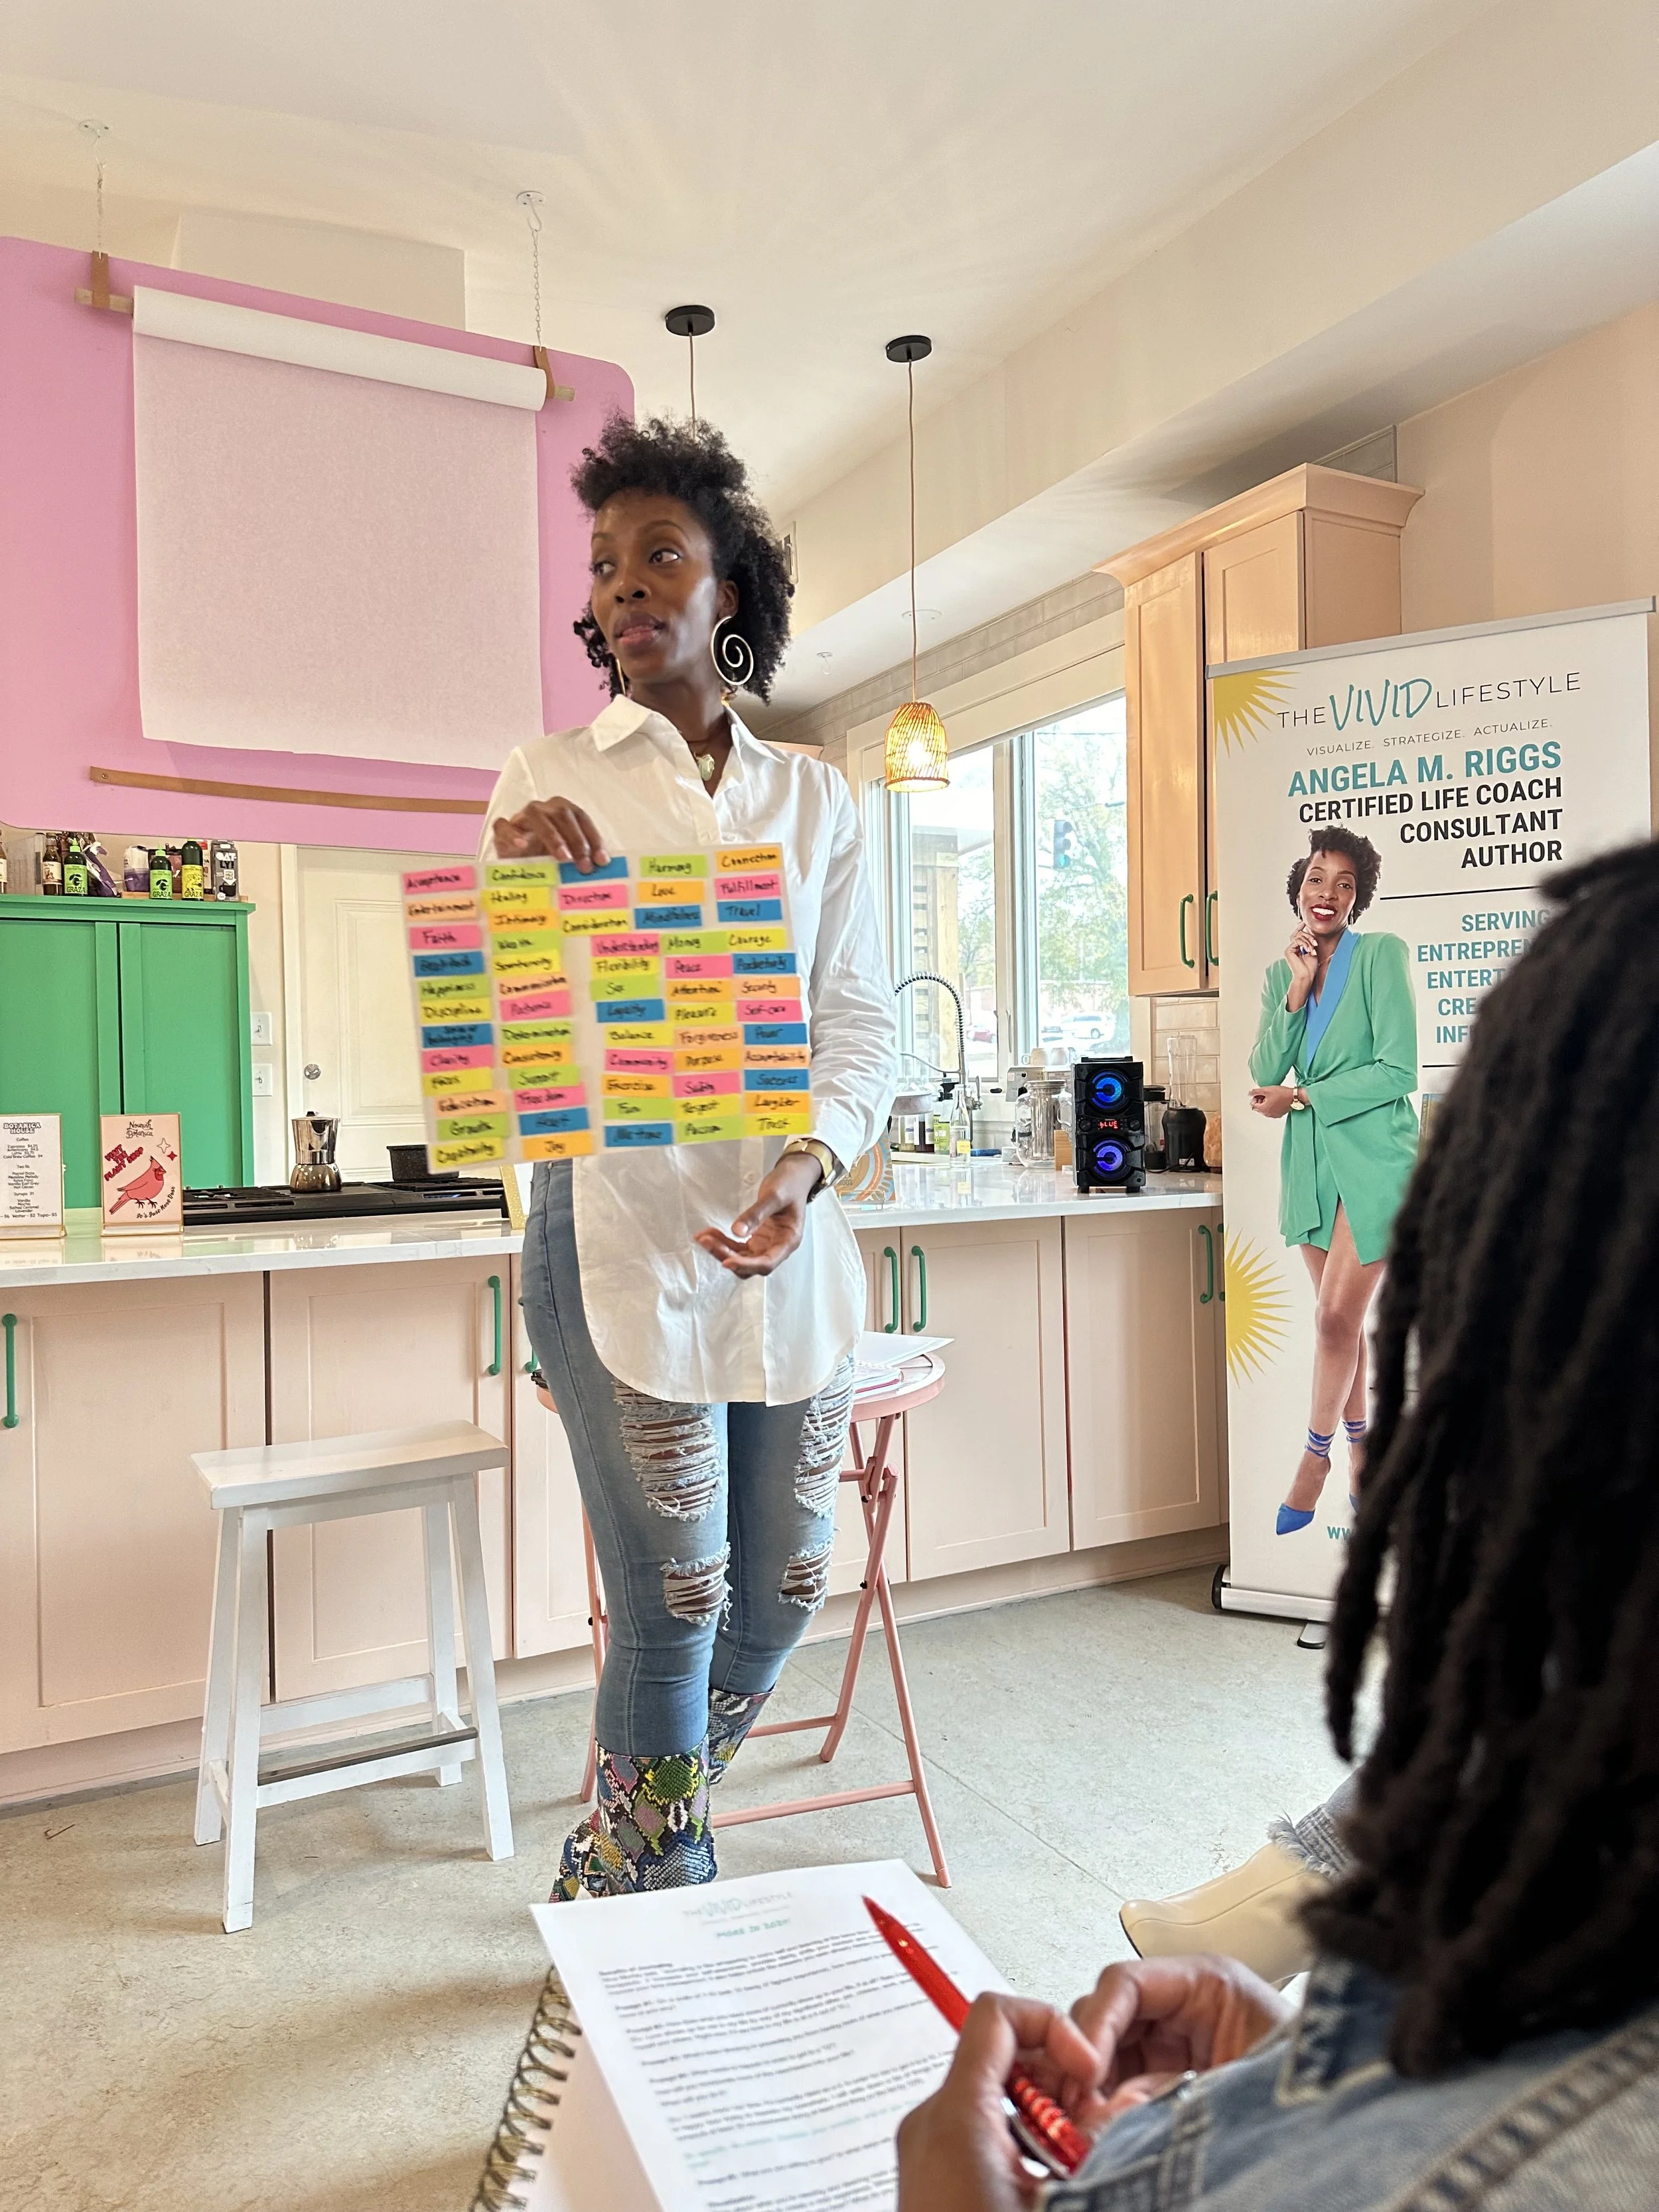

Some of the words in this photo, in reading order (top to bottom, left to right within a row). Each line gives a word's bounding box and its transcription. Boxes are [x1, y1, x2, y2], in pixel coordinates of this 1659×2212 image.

[1277, 707, 1326, 728] THE
[1329, 679, 1433, 731] VIVID
[1437, 672, 1581, 708] LIFESTYLE
[1383, 729, 1465, 747] STRATEGIZE.
[1473, 718, 1553, 737] ACTUALIZE.
[1287, 759, 1407, 797] ANGELA
[1418, 755, 1454, 783] M.
[1465, 741, 1561, 777] RIGGS
[1299, 792, 1413, 823] CERTIFIED
[1421, 786, 1469, 811] LIFE
[1477, 776, 1562, 806] COACH
[1400, 808, 1563, 844] CONSULTANT
[722, 853, 776, 867] Connection
[1461, 840, 1563, 869] AUTHOR
[650, 863, 691, 874] Harmony
[492, 869, 545, 881] Confidence
[652, 885, 675, 897] Love
[721, 880, 777, 893] Fulfillment
[491, 893, 527, 902] Healing
[562, 893, 611, 905] Direction
[409, 901, 474, 916] Entertainment
[726, 904, 760, 916] Travel
[496, 915, 546, 925] Intimacy
[563, 919, 626, 932] Consideration
[1461, 909, 1551, 932] SERVING
[423, 931, 456, 944] Faith
[668, 937, 700, 949] Money
[729, 934, 771, 946] Courage
[596, 958, 649, 971] Flexibility
[607, 983, 624, 995] Sex
[742, 982, 776, 994] Security
[423, 1003, 482, 1018] Discipline
[676, 1007, 716, 1019] Pleasure
[609, 1031, 653, 1040] Balance
[680, 1032, 738, 1045] Forgiveness
[517, 1092, 564, 1104] Freedom
[618, 1102, 640, 1114] Fun
[127, 1120, 153, 1130] Nourish
[757, 1118, 790, 1128] Trust
[126, 1130, 153, 1139] Botanica
[544, 1140, 564, 1154] Joy
